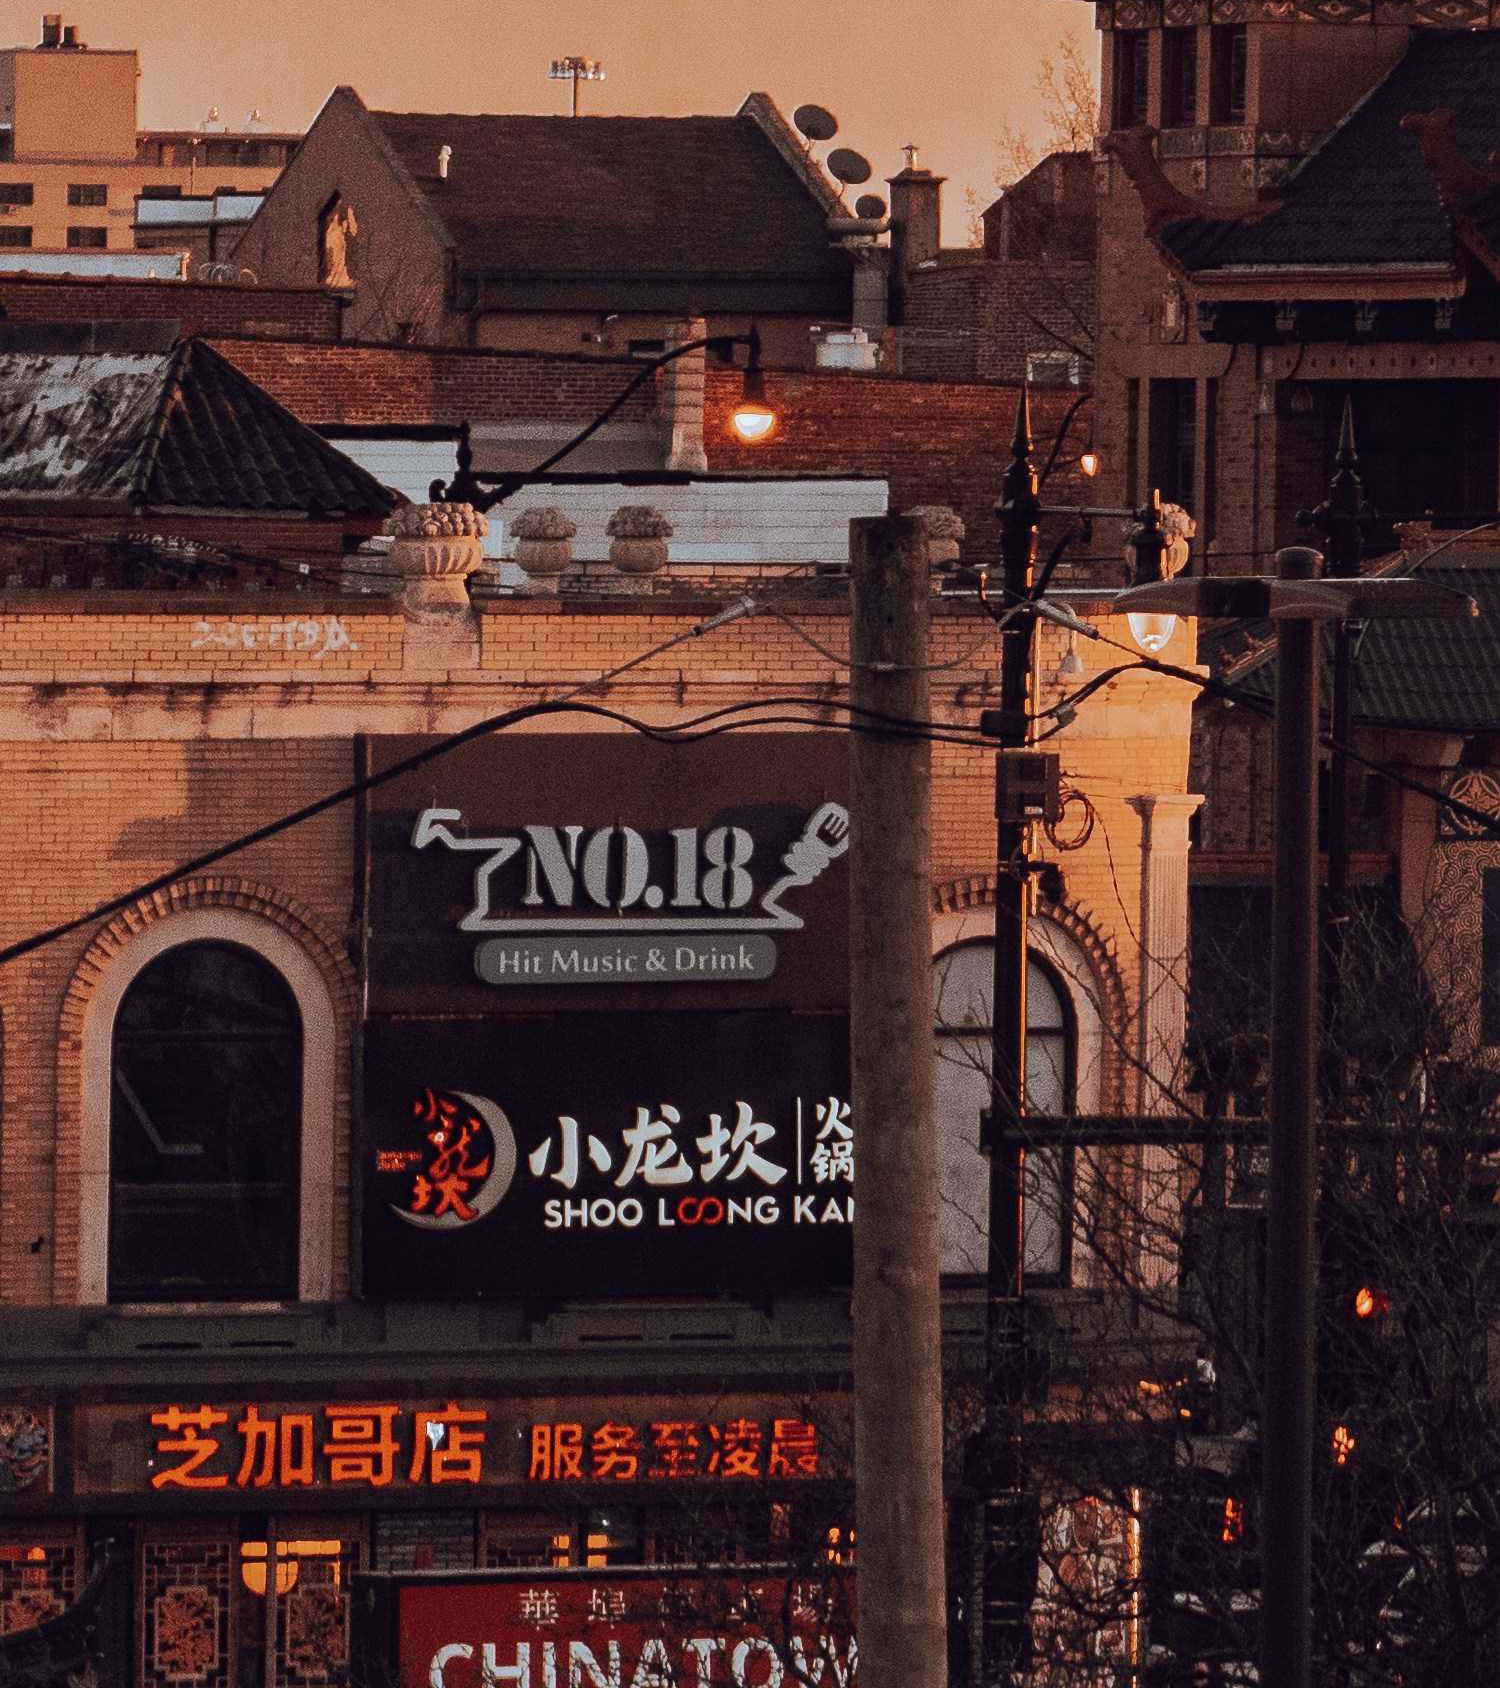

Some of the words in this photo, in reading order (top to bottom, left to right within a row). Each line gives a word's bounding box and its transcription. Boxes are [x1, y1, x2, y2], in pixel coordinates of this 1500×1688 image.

[522, 825, 755, 909] NO.18
[499, 949, 542, 974] Hit
[551, 948, 637, 974] Music
[646, 948, 667, 972] &
[675, 945, 755, 972] Drink
[528, 1101, 788, 1189] 小龙坎
[809, 1096, 855, 1183] 火锅
[544, 1197, 643, 1228] SHOO
[659, 1196, 780, 1227] LOONG
[795, 1195, 855, 1225] KA
[150, 1402, 487, 1488] 芝加哥店
[530, 1418, 819, 1482] 服务至凌晨
